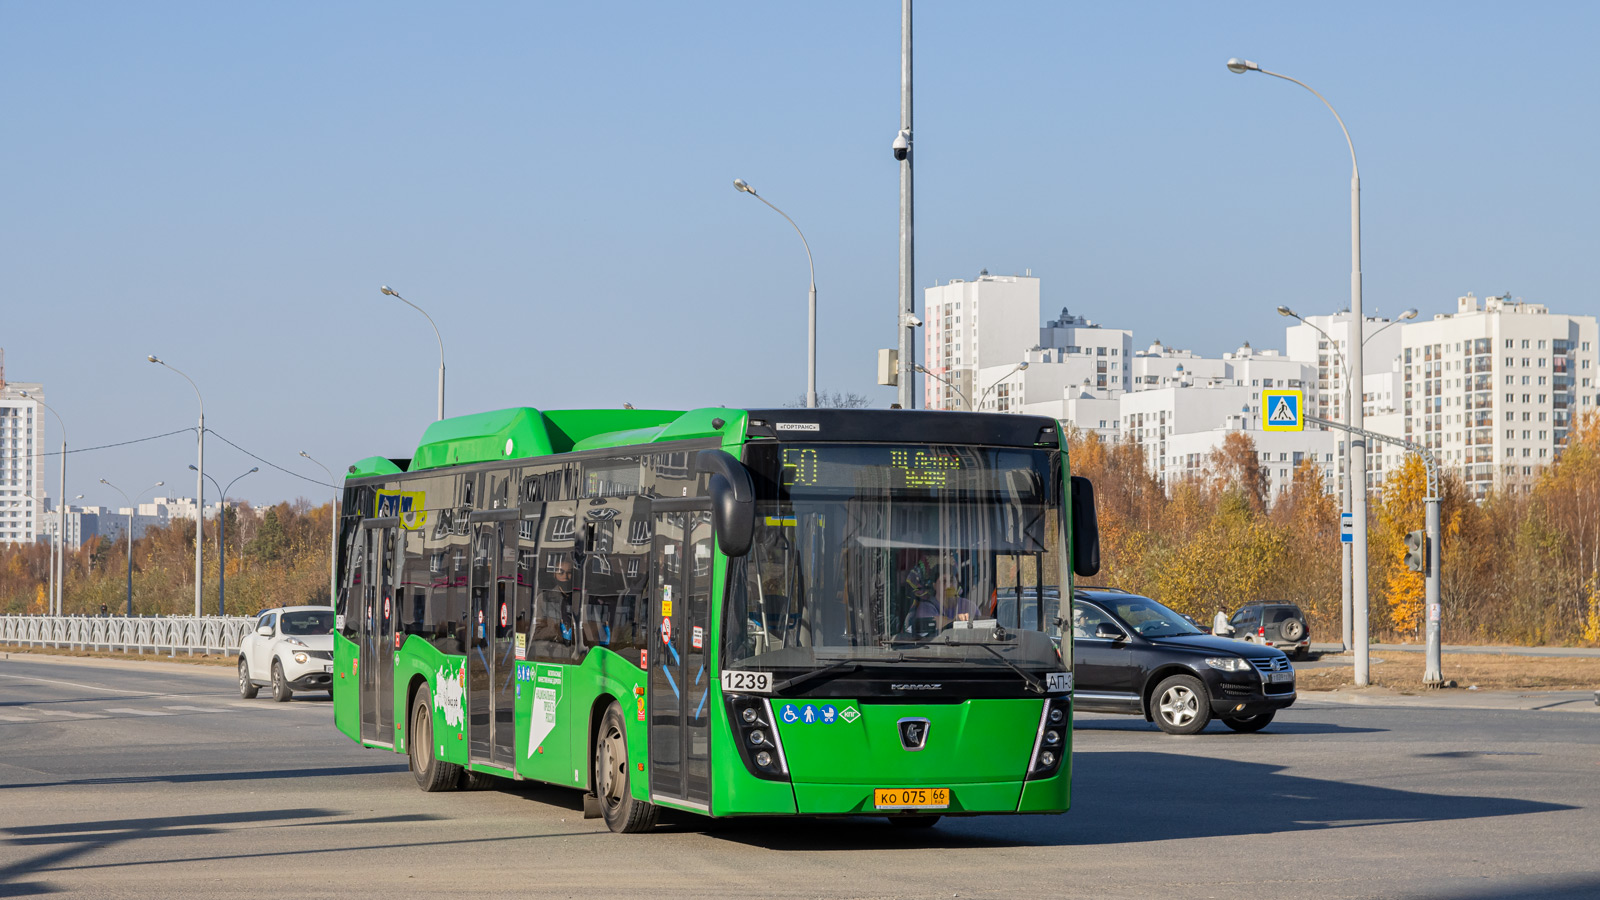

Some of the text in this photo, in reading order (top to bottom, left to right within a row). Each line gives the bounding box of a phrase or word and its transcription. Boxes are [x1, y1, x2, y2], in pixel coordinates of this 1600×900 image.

[783, 449, 817, 486] 50
[724, 673, 767, 690] 1239
[902, 790, 926, 804] 075
[932, 789, 945, 800] 66
